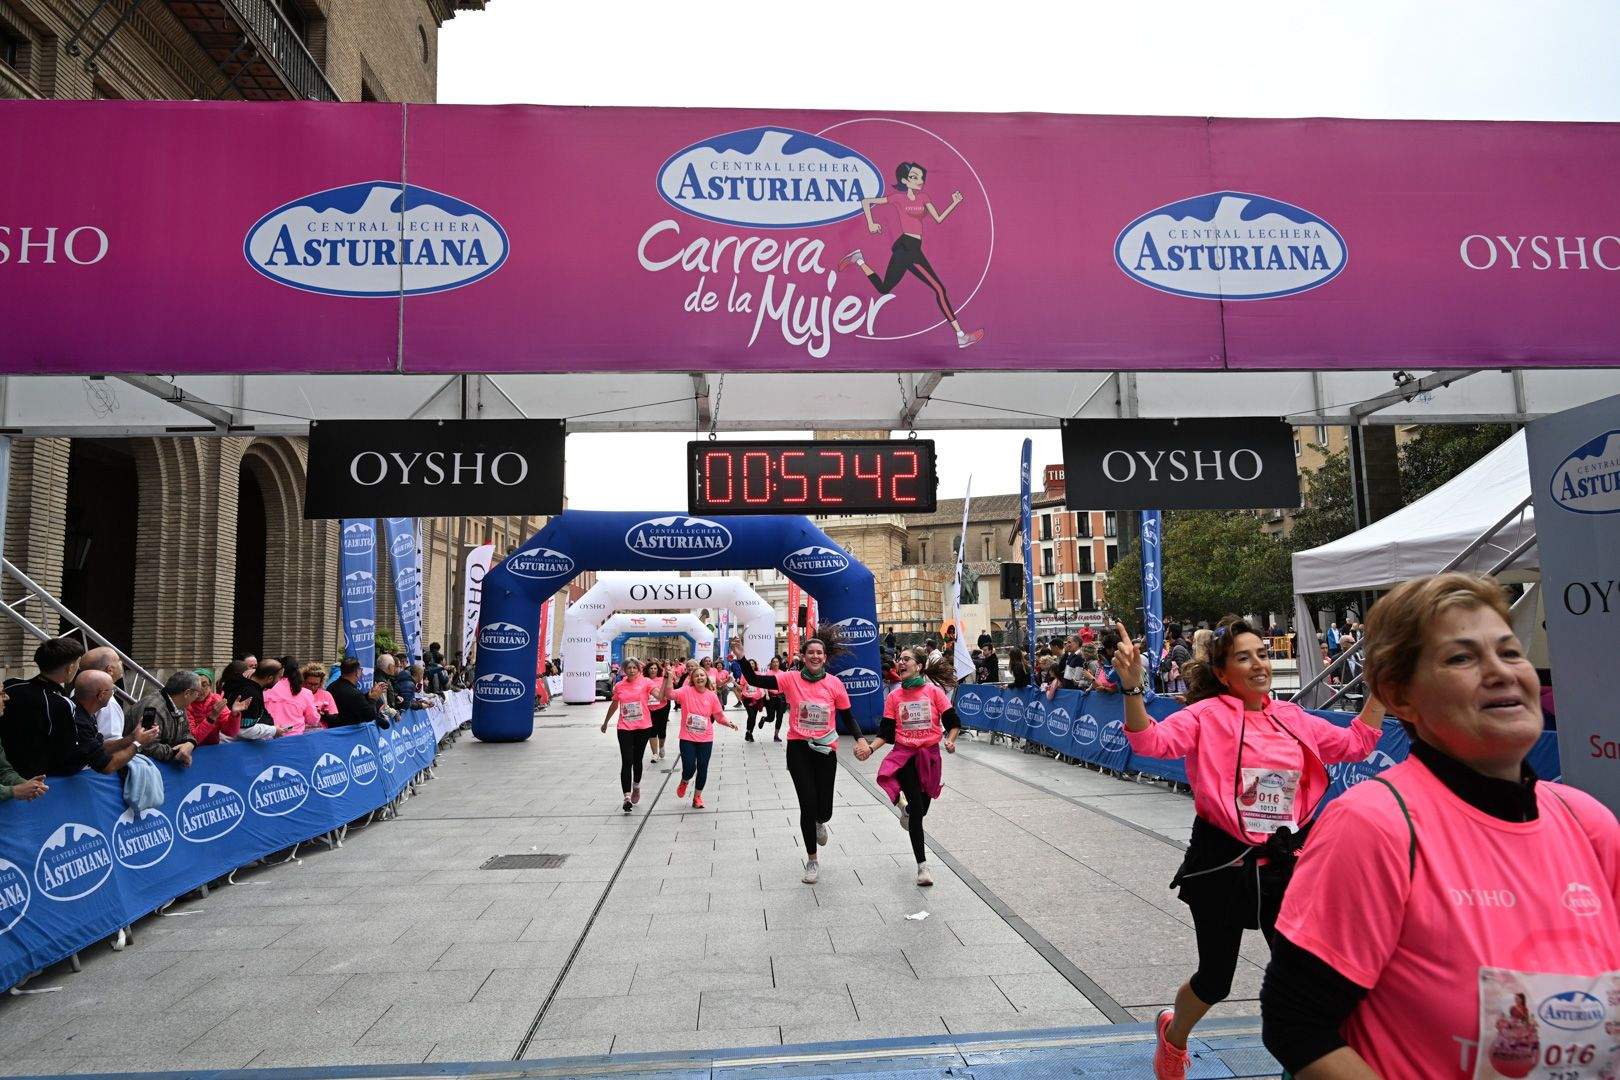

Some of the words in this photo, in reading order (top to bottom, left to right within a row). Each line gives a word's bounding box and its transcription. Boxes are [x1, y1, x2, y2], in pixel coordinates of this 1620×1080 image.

[710, 161, 782, 171] CENTRAL
[788, 163, 859, 173] LECHERA
[674, 162, 866, 202] ASTURIANA
[307, 222, 389, 232] CENTRAL
[398, 221, 481, 232] LECHERA
[1168, 229, 1241, 239] CENTRAL
[1248, 229, 1321, 239] LECHERA
[264, 224, 489, 267] ASTURIANA
[637, 219, 826, 274] Carrera
[1134, 231, 1332, 271] ASTURIANA
[1460, 234, 1620, 271] OYSHO
[684, 276, 719, 313] de
[727, 276, 752, 313] la
[748, 271, 897, 358] Mujer
[350, 451, 529, 486] OYSHO
[1048, 470, 1065, 480] TIB
[1102, 448, 1264, 483] OYSHO
[633, 530, 724, 549] ASTURIANA
[510, 558, 569, 571] ASTURIANA
[789, 558, 845, 570] ASTURIANA
[630, 583, 712, 601] OYSHO
[1563, 580, 1620, 616] OY
[255, 783, 306, 809] ASTURIANA
[1258, 792, 1280, 803] 016
[182, 802, 242, 835] ASTURIANA
[118, 826, 171, 859] ASTURIANA
[51, 849, 78, 863] CENTRAL
[43, 848, 111, 892] ASTURIANA
[1545, 1004, 1601, 1021] ASTURIAN
[1545, 1044, 1596, 1066] 016
